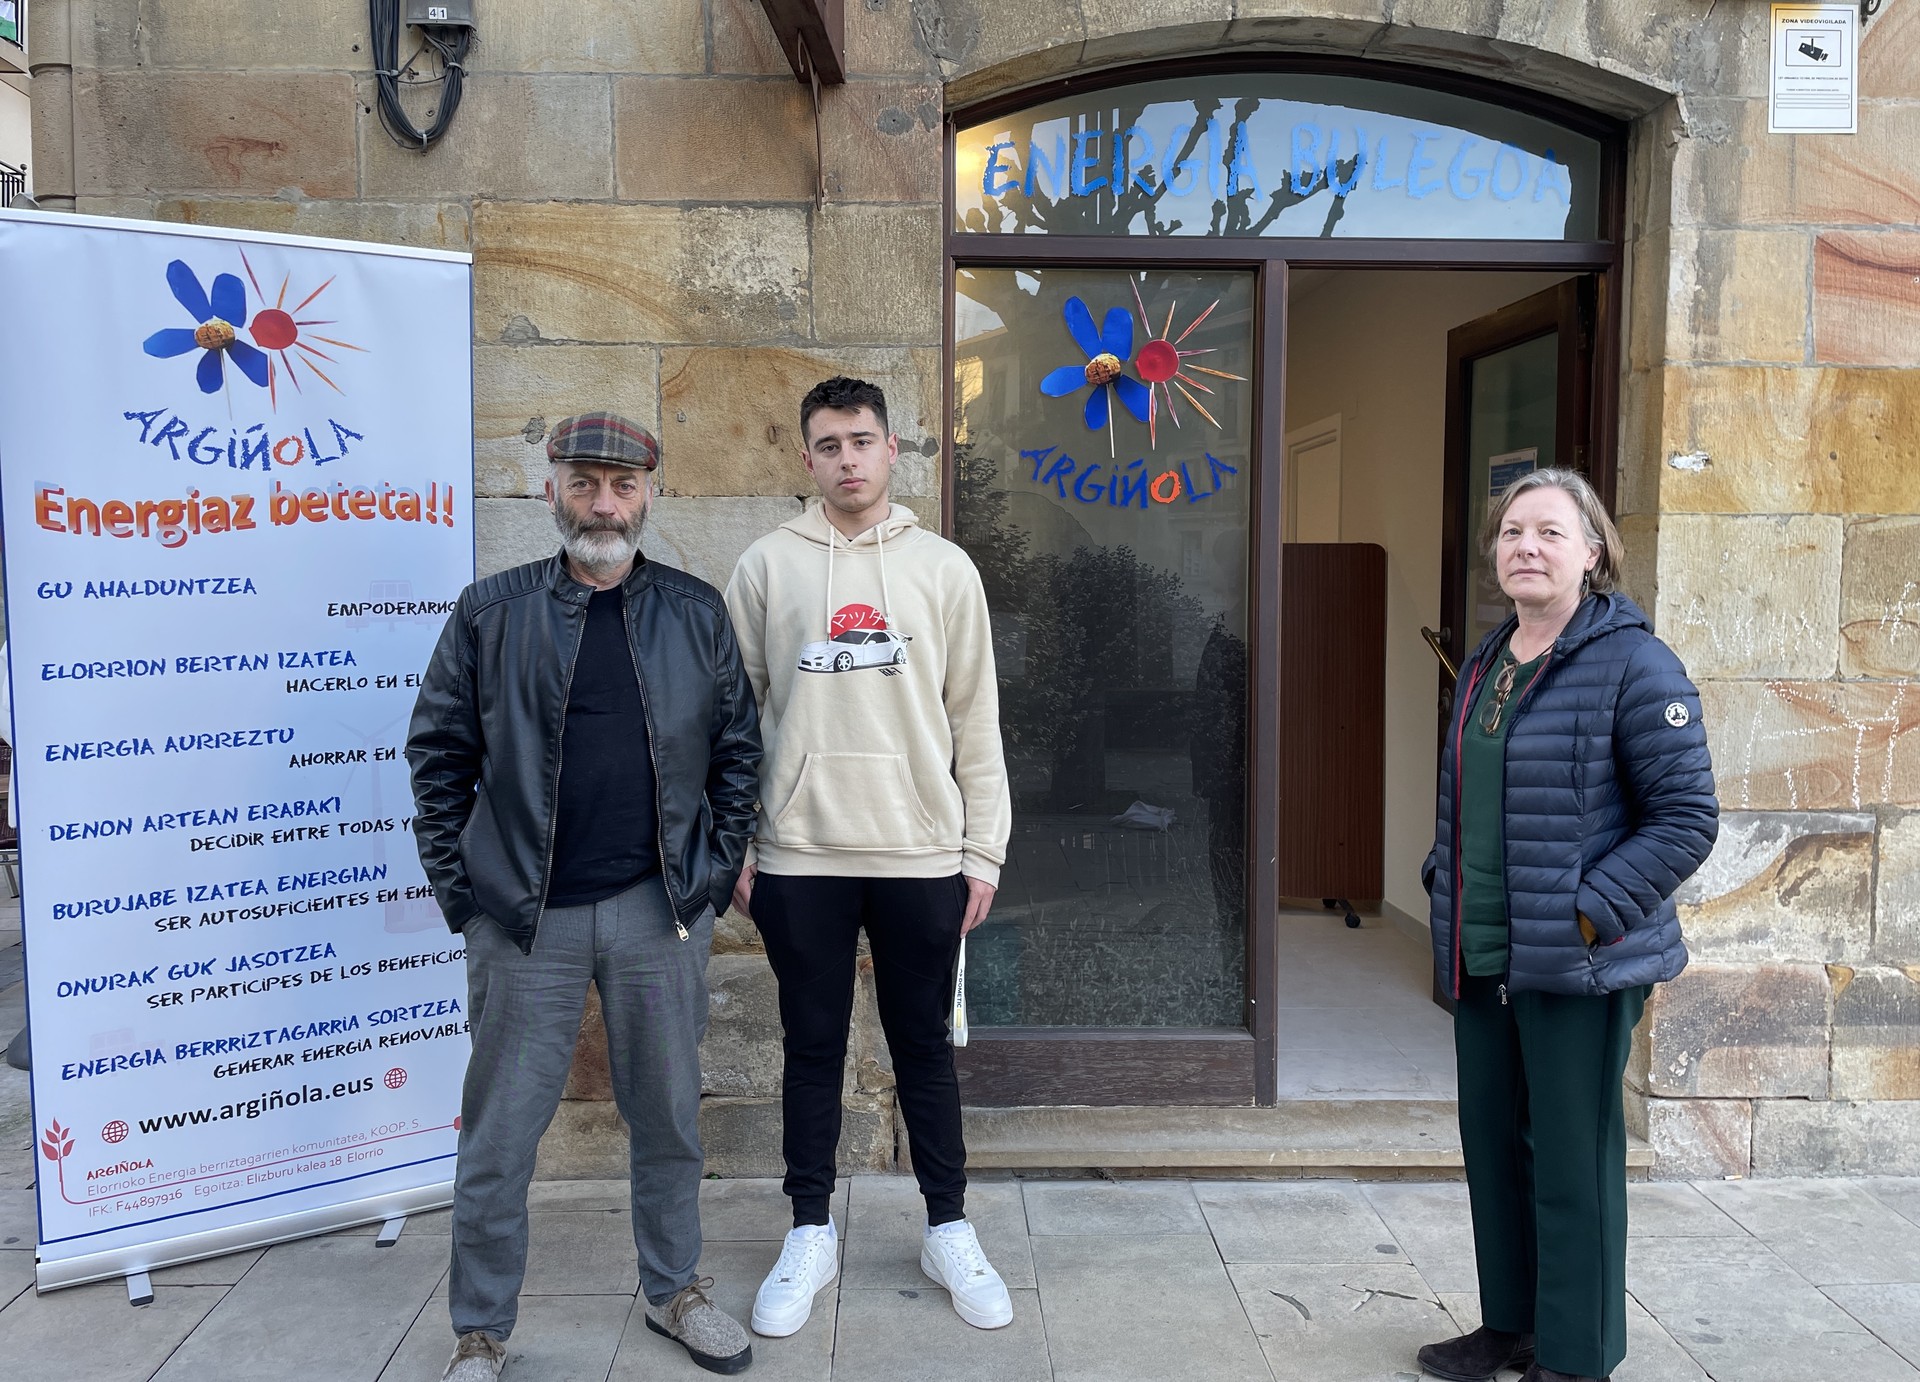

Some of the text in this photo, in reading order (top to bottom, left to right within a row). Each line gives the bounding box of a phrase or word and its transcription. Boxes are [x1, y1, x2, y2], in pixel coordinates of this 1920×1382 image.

[430, 8, 444, 18] 41
[982, 118, 1568, 204] ENERGIA BULEGOA
[34, 477, 454, 548] Energiaz beteta!!
[37, 577, 257, 600] GU AHALDUNTZEA
[41, 650, 357, 681] ELORRION BERTAN IZATEA
[286, 675, 368, 694] HACERLO
[375, 674, 397, 689] EN
[46, 728, 295, 762] ENERGIA AURREZTU
[289, 749, 367, 768] AHORRAR
[373, 746, 396, 761] EN
[50, 796, 341, 842] DENON ARTEAN ERABAKI
[271, 823, 330, 844] ENTRE
[338, 818, 395, 836] TODAS
[401, 817, 411, 832] Y
[53, 864, 387, 921] BURUJABE IZATEA ENERGIAN
[155, 915, 192, 933] SER
[376, 888, 398, 903] EN
[57, 942, 337, 998] ONURAK GUK JASOTZEA
[147, 992, 184, 1010] SER
[310, 968, 333, 984] DE
[340, 962, 371, 980] LOS
[62, 1049, 167, 1082] ENERGIA
[367, 998, 461, 1027] SORTZEA
[213, 1053, 295, 1079] GENERAR
[139, 1075, 374, 1135] www.argiñola.eus
[86, 1158, 154, 1180] ARGIÑOLA
[87, 1118, 422, 1196] Elorrioko Energia berriztagarrien komunitatea, KOOP. S.
[89, 1147, 384, 1218] IFK: F44897916 Egoitza: Elizburu kalea 18 Elorrio
